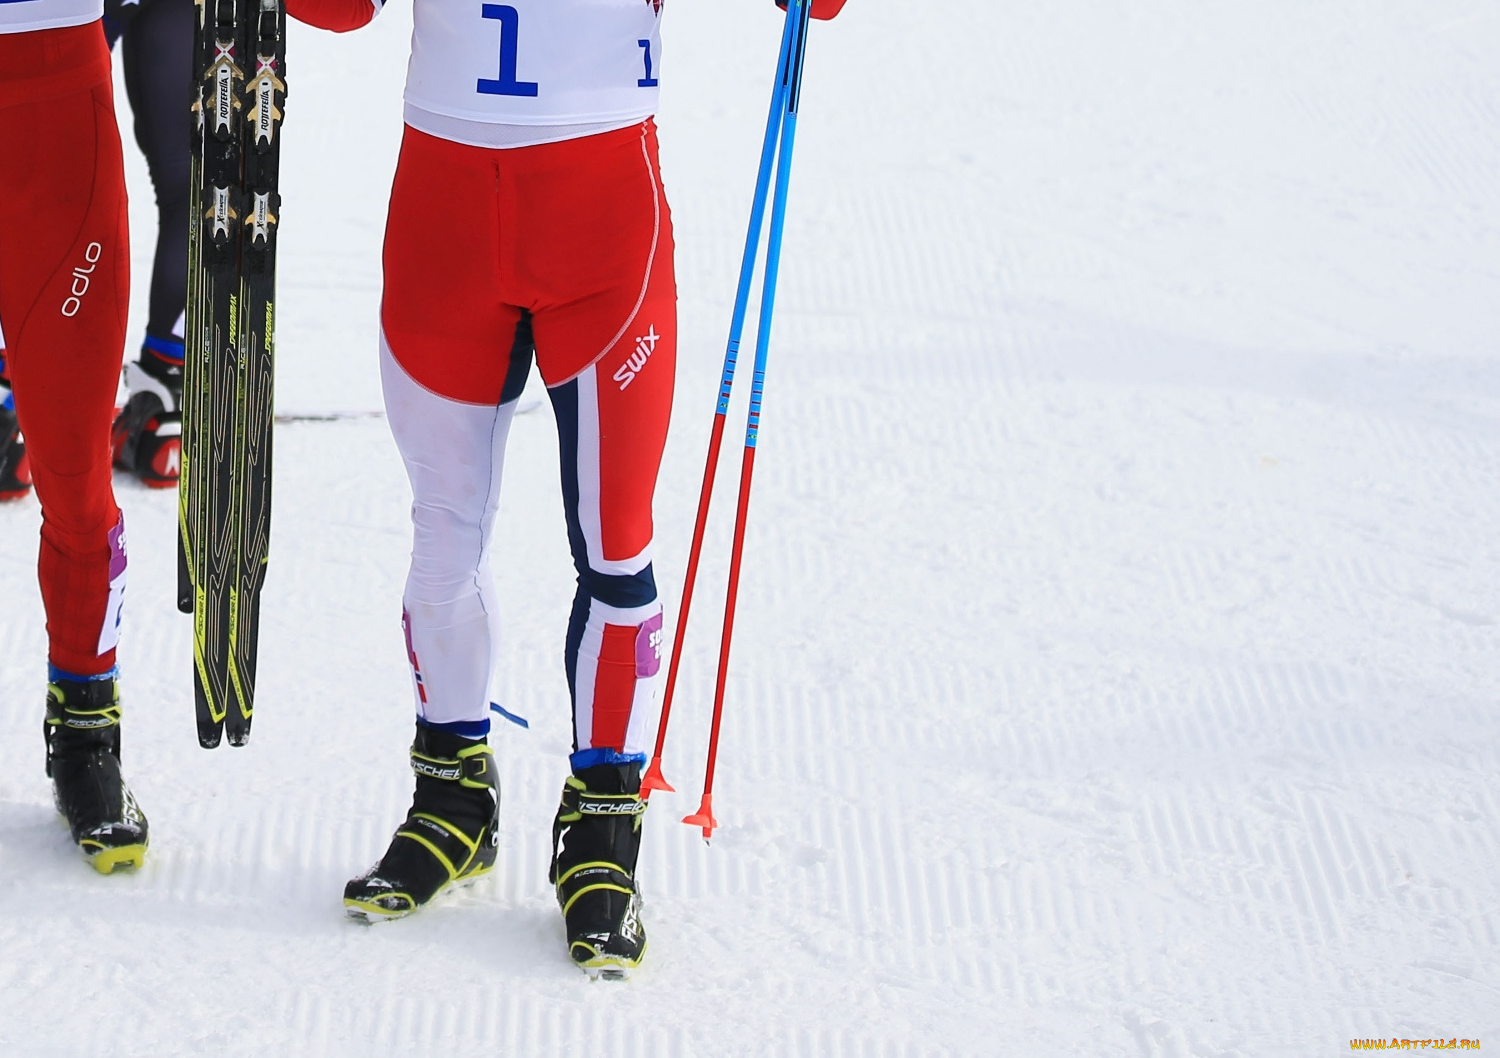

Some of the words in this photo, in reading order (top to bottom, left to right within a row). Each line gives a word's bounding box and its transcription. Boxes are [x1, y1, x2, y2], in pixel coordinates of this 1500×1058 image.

[476, 3, 539, 98] 1
[637, 39, 658, 88] 1
[61, 242, 102, 317] odlo
